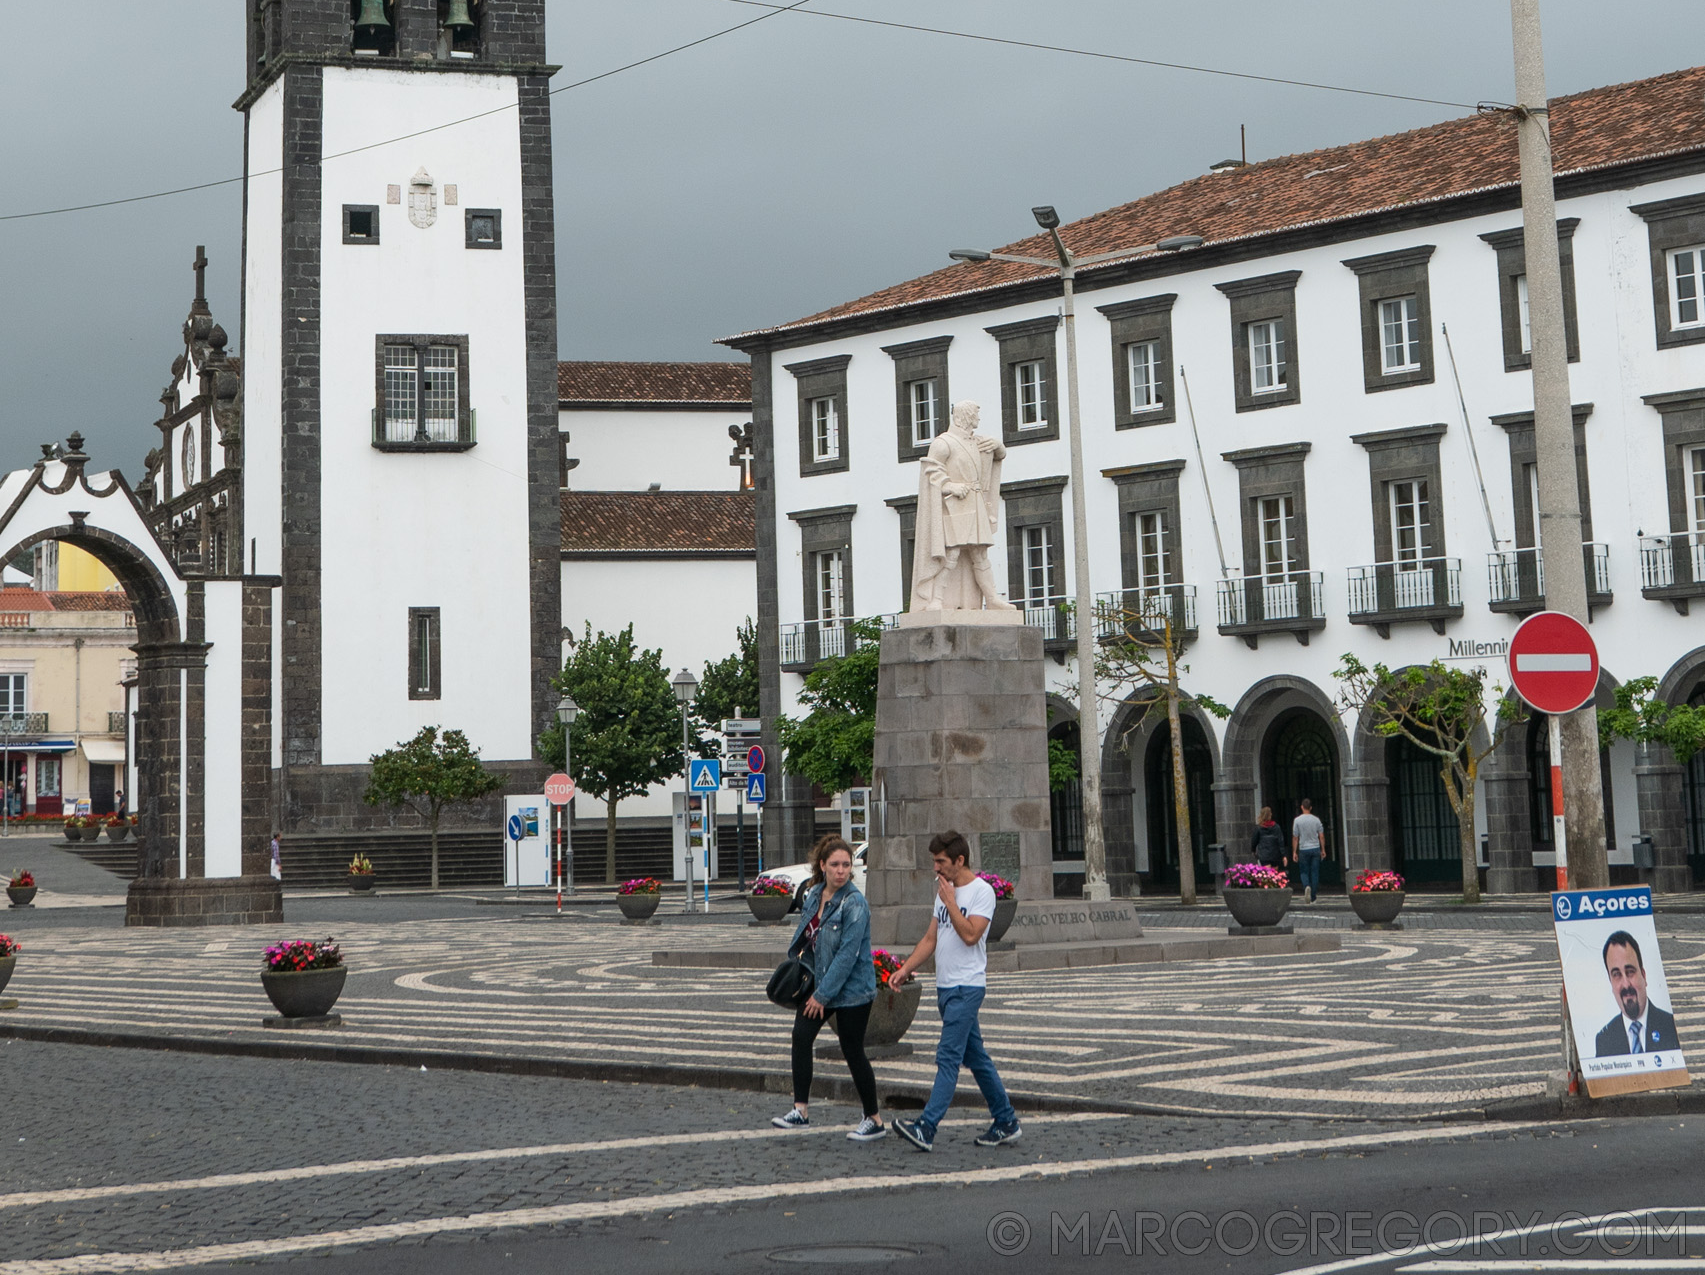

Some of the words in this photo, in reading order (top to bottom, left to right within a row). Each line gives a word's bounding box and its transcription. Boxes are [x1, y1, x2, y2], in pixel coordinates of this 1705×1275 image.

[546, 784, 572, 794] STOP
[1579, 895, 1649, 916] Açores
[1011, 914, 1048, 927] NÇALO
[1050, 912, 1087, 925] VELHO
[1088, 909, 1132, 923] CABRAL
